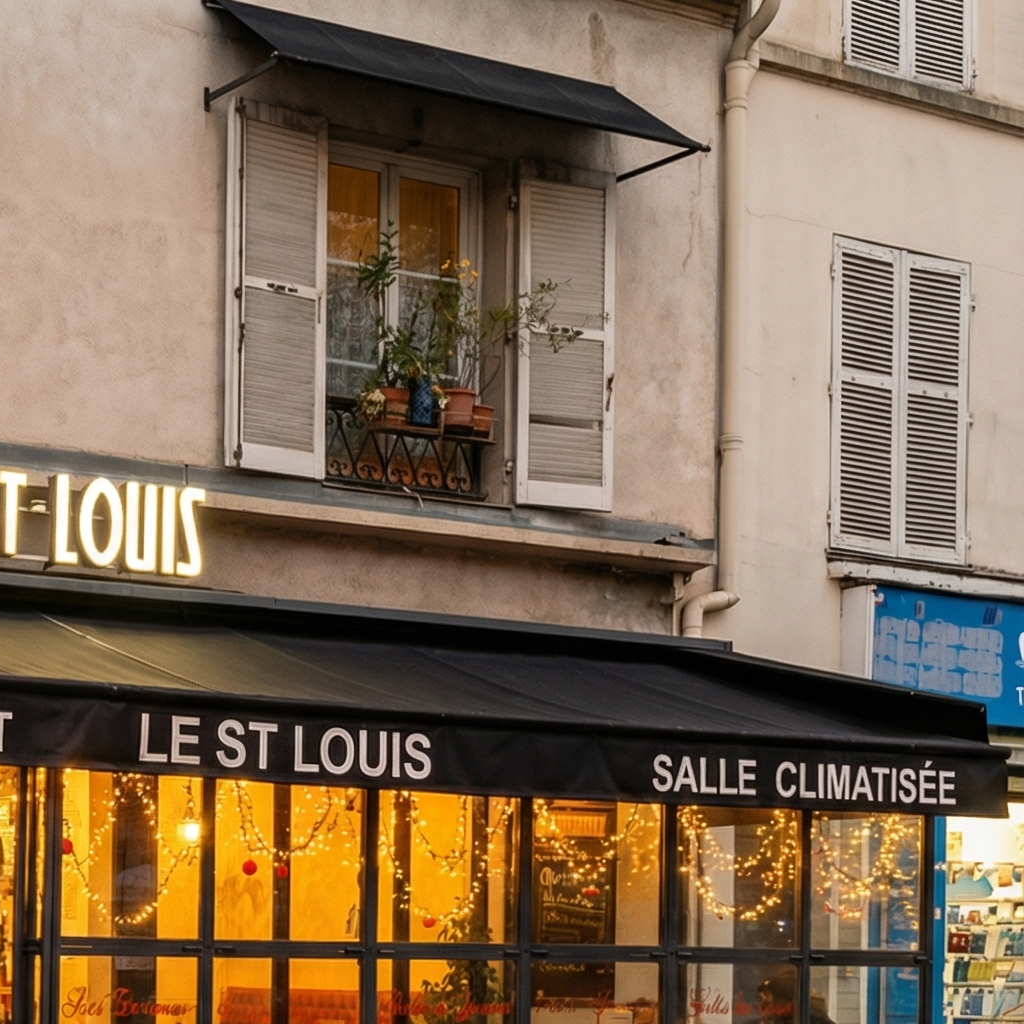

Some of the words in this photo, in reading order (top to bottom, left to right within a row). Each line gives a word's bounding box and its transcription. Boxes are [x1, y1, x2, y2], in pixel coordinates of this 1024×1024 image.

[138, 712, 201, 765] LE
[216, 718, 278, 770] ST
[294, 725, 432, 780] LOUIS
[652, 754, 757, 796] SALLE
[775, 760, 957, 805] CLIMATISÉE
